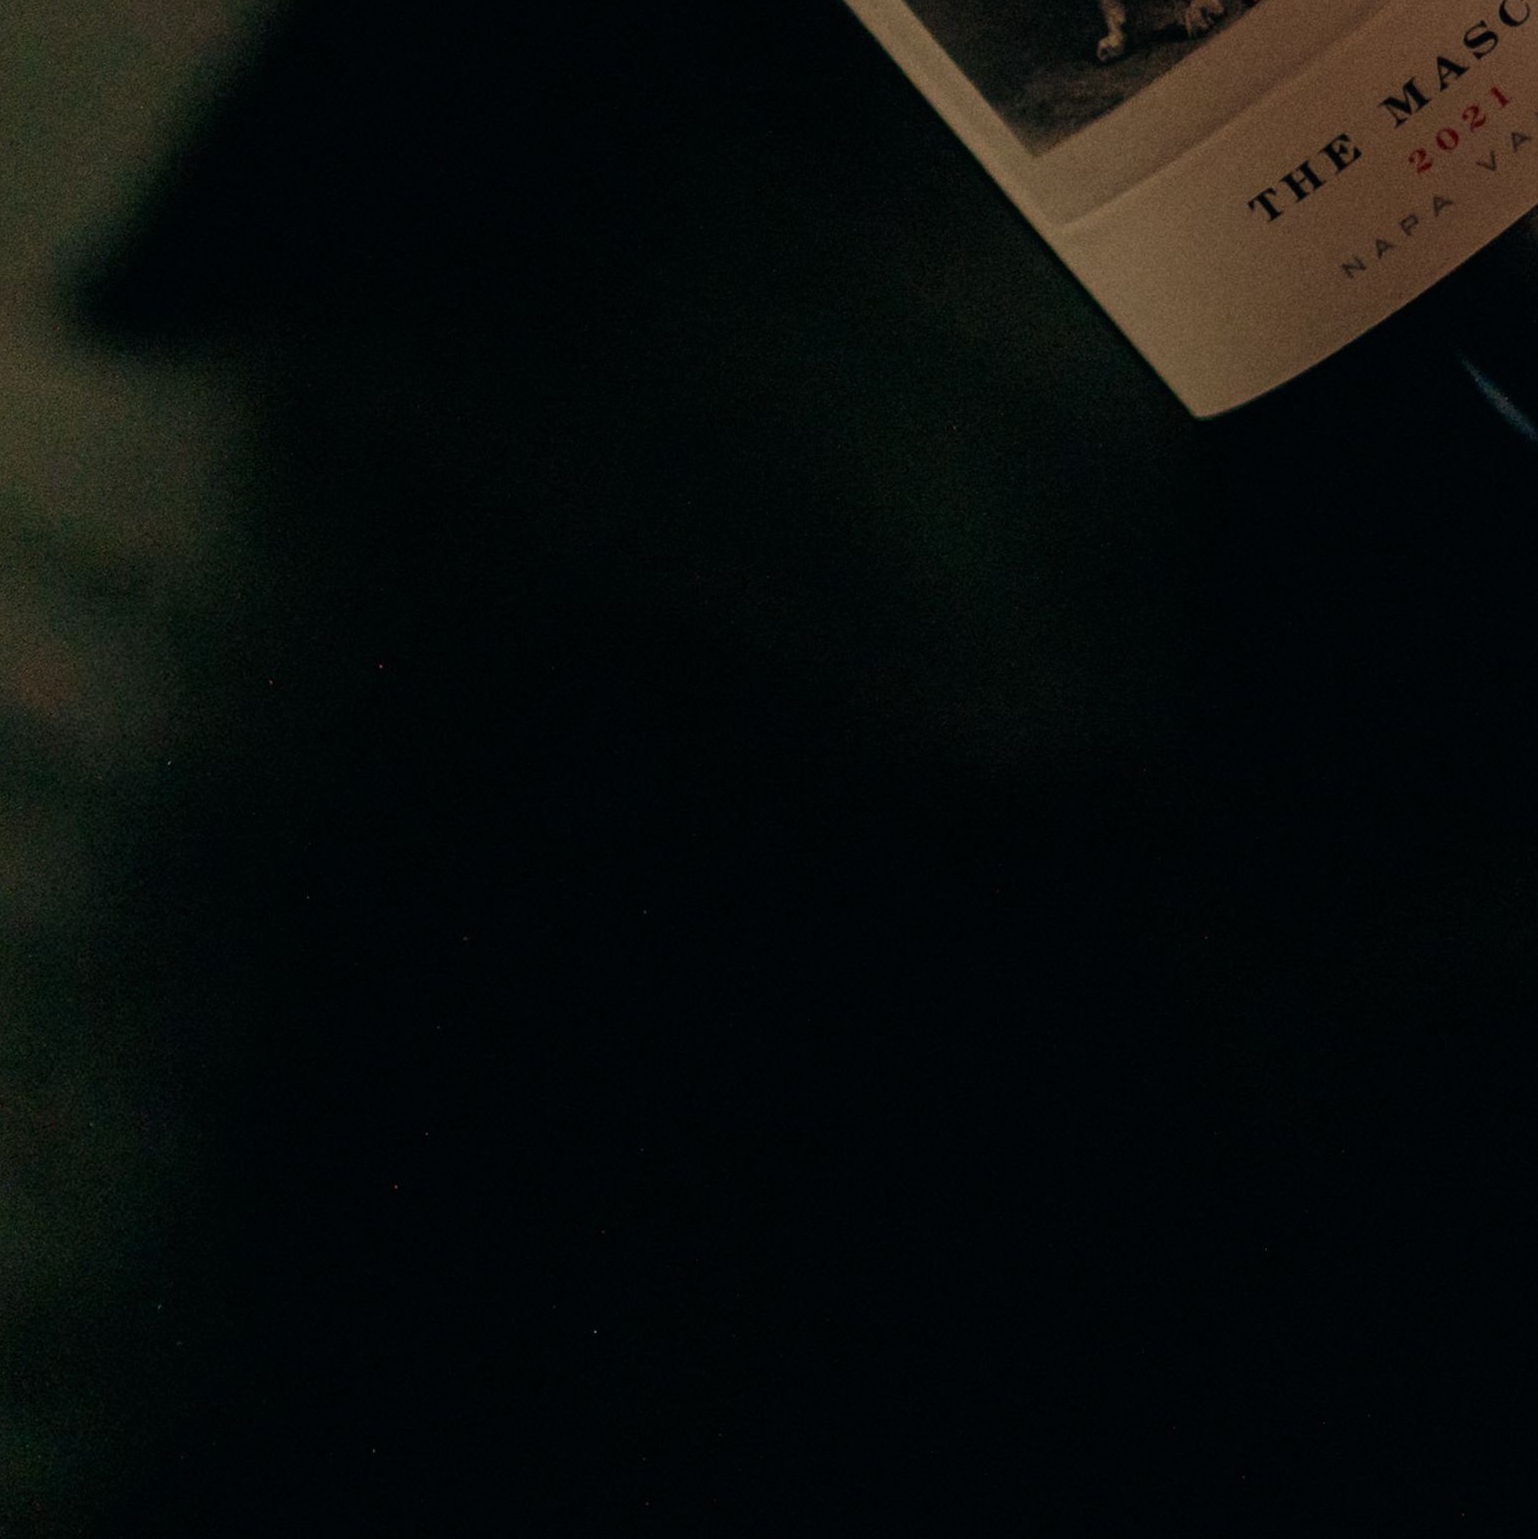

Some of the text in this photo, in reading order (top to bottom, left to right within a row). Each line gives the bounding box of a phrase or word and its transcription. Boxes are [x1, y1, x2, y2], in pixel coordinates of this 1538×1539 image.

[1409, 87, 1510, 173] 2021
[1248, 133, 1361, 223] THE
[1341, 194, 1454, 279] NAPA
